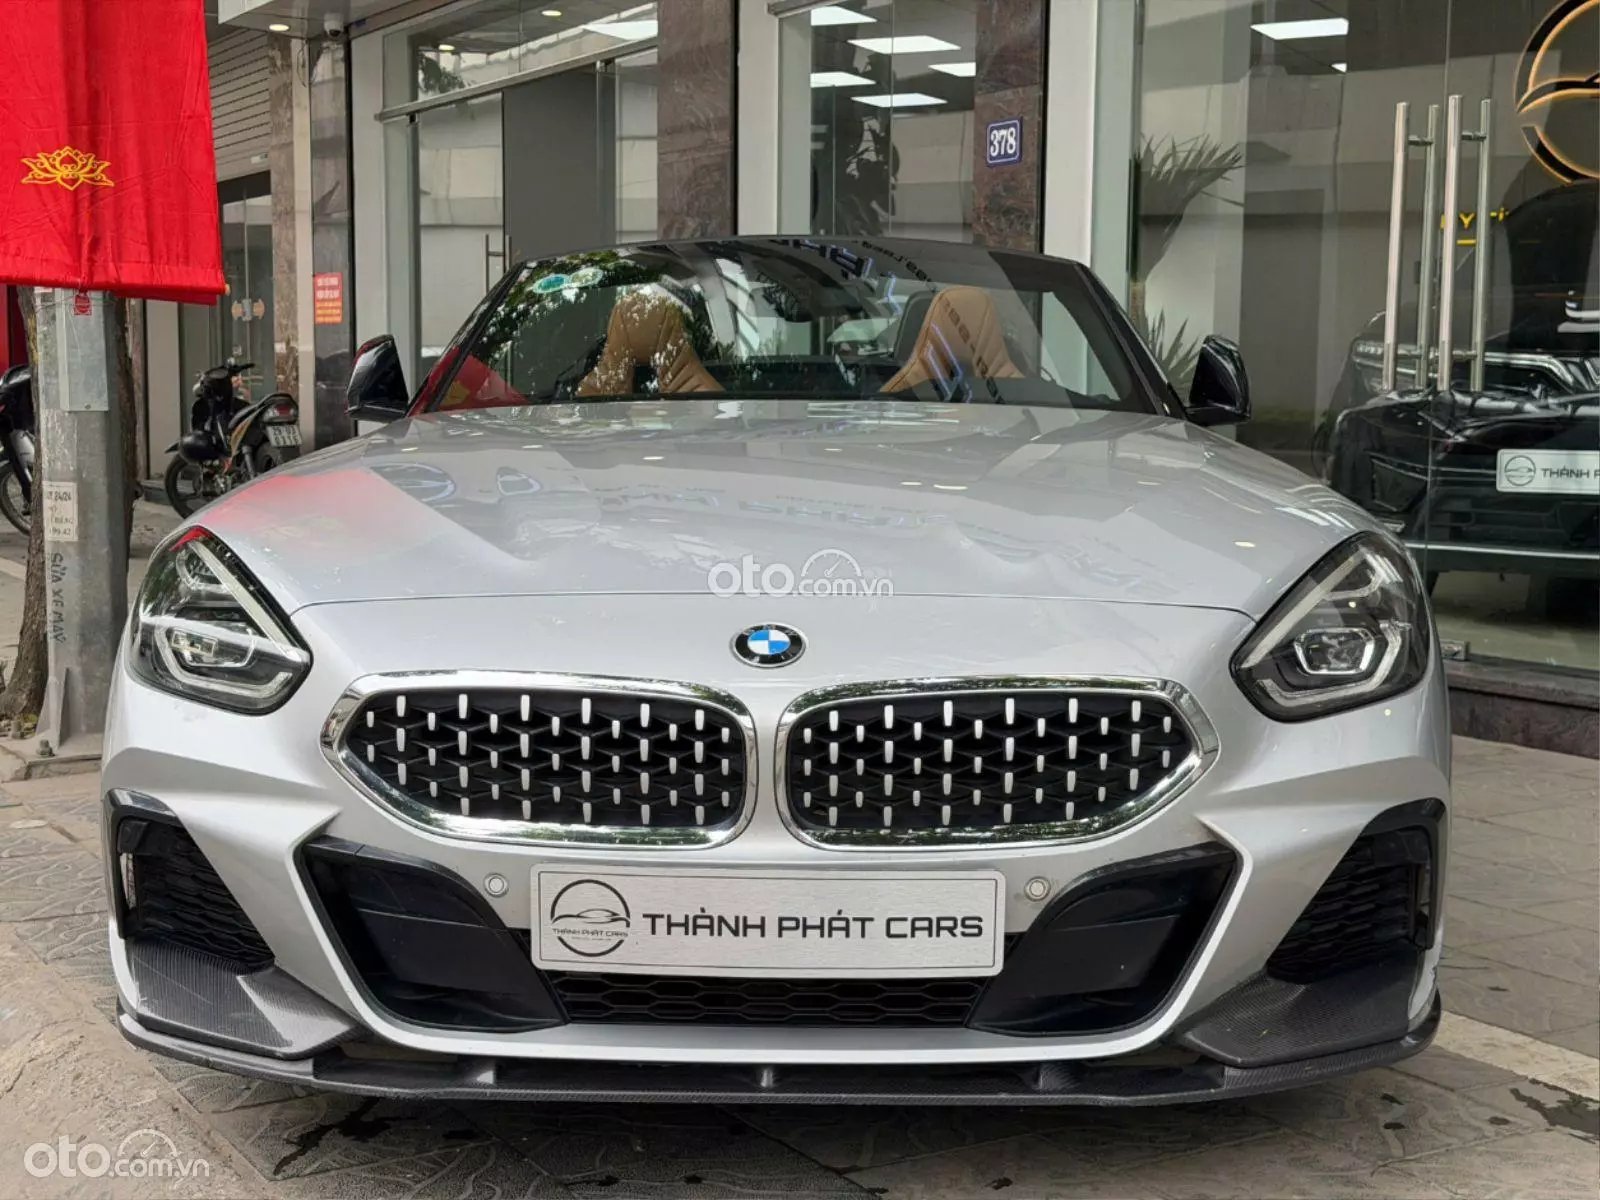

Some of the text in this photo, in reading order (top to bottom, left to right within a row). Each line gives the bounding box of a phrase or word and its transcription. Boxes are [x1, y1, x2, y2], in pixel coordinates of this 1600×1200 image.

[990, 127, 1016, 157] 378
[642, 907, 984, 938] THÀNH PHÁT CARS
